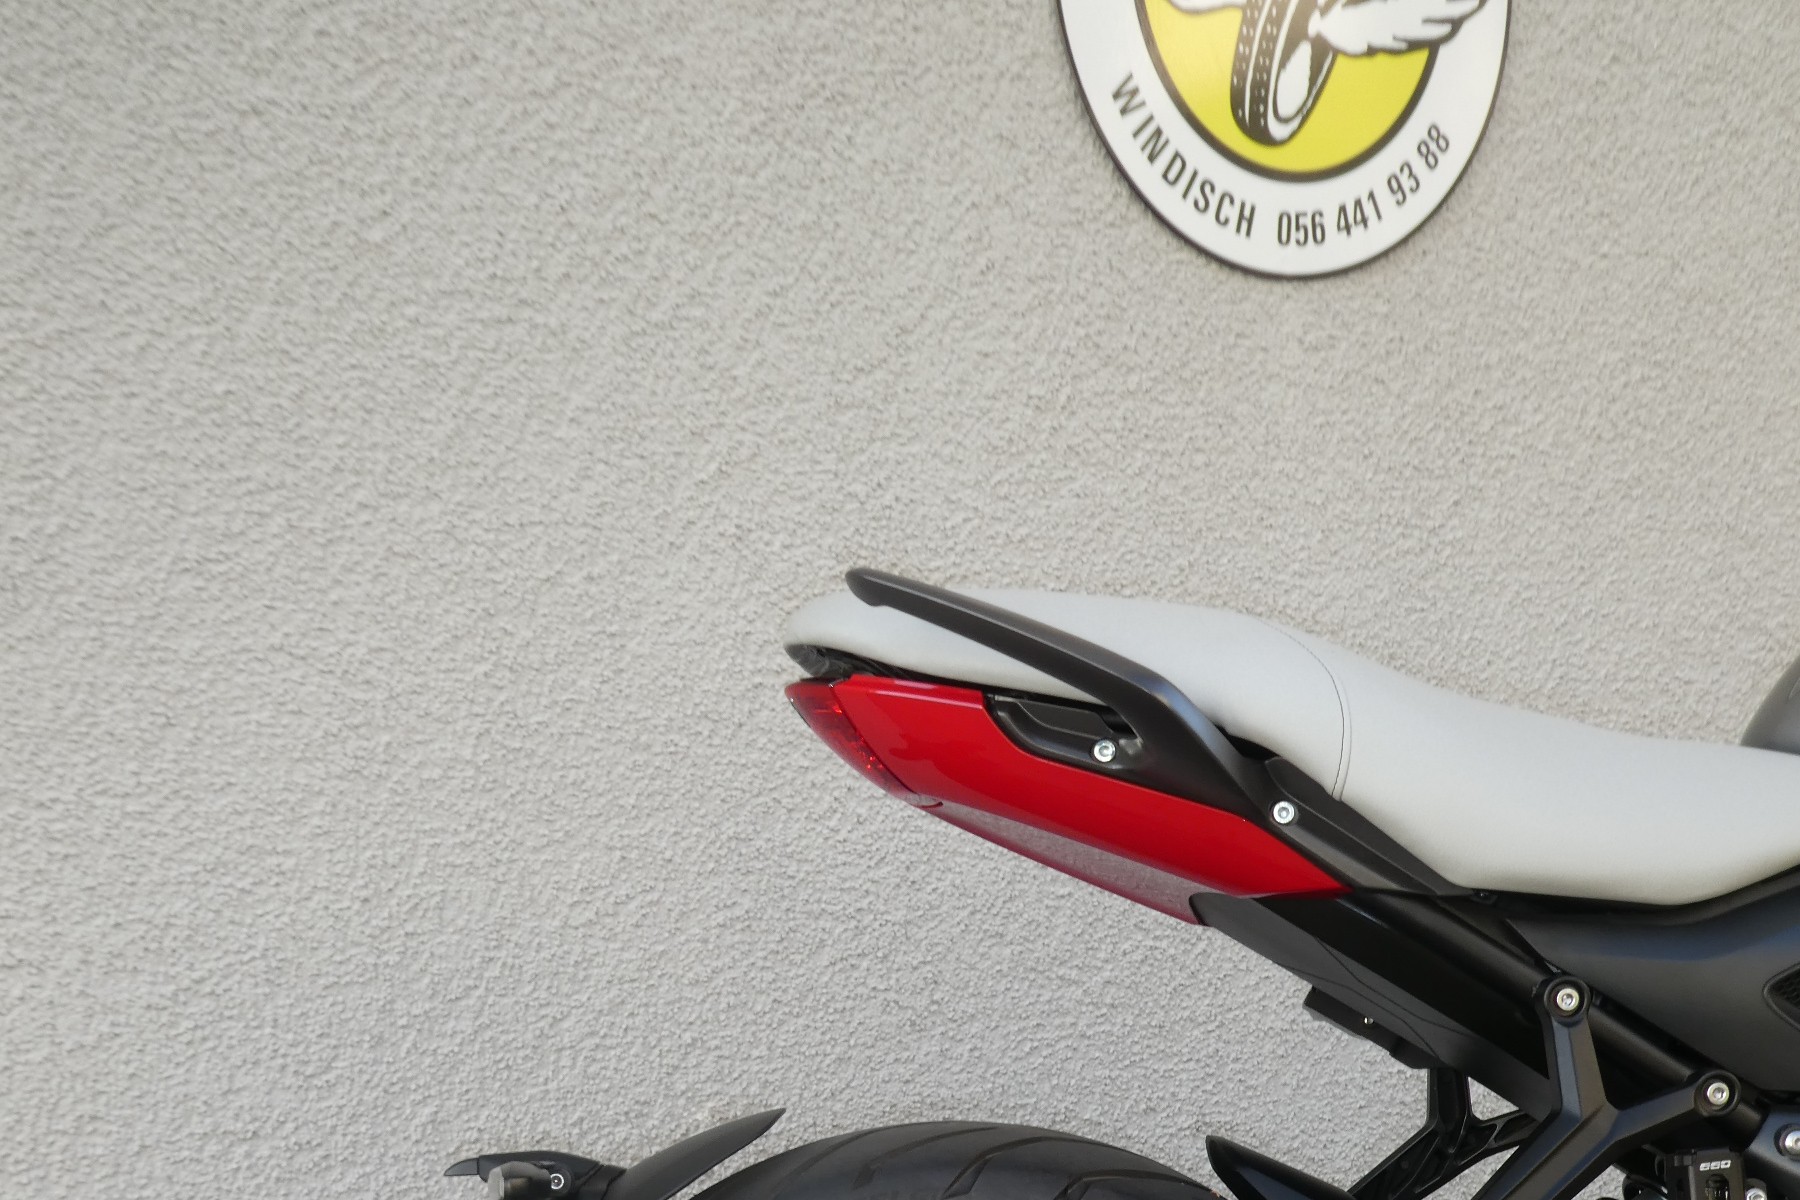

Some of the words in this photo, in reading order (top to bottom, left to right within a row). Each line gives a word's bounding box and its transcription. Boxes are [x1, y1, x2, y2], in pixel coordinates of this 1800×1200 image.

[1111, 72, 1256, 239] WINDISCH
[1276, 211, 1326, 247] 056
[1336, 190, 1384, 239] 441
[1387, 160, 1422, 207] 93
[1416, 123, 1451, 168] 88
